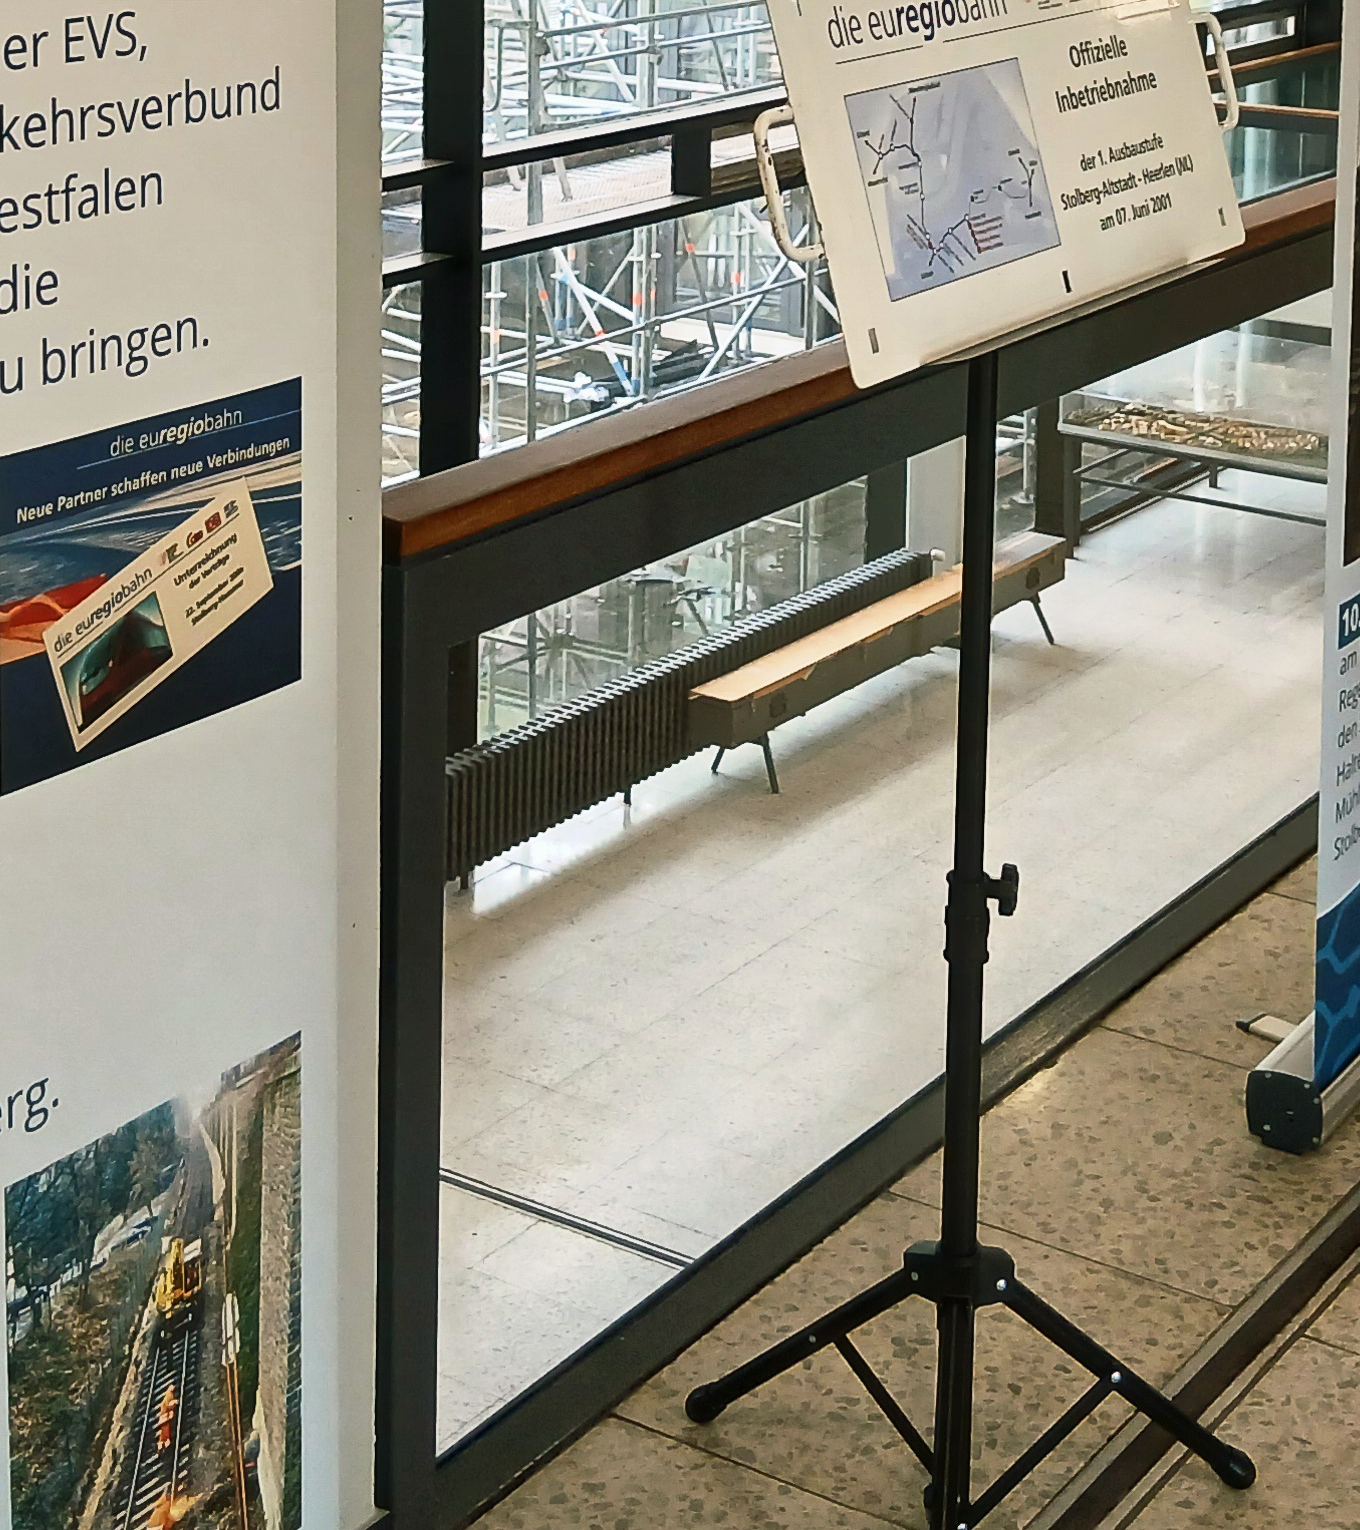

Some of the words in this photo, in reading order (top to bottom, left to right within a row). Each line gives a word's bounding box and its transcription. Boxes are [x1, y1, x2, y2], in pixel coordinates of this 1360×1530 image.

[63, 10, 149, 64] EVS,
[827, 7, 864, 50] die
[1069, 34, 1129, 69] Offizielle
[1055, 70, 1158, 114] Inbetriebnahme
[1080, 153, 1096, 172] der
[1098, 150, 1108, 166] 1.
[1109, 132, 1165, 163] Ausbaustufe
[1060, 171, 1138, 211] Stolberg-Altstadt
[1175, 154, 1194, 176] (NL)
[1099, 214, 1115, 232] am
[1115, 206, 1131, 227] 07.
[1131, 198, 1150, 222] Juni
[1150, 191, 1173, 215] 2001
[42, 314, 210, 384] bringen.
[110, 433, 135, 458] die
[139, 408, 242, 450] euregiobahn
[16, 502, 53, 525] Neue
[57, 485, 108, 513] Partner
[111, 470, 168, 499] schaffen
[171, 460, 204, 482] neue
[206, 435, 291, 470] Verbindungen
[173, 532, 238, 587] Unterzeichnung
[53, 630, 74, 654] die
[75, 567, 154, 636] euregiobahn
